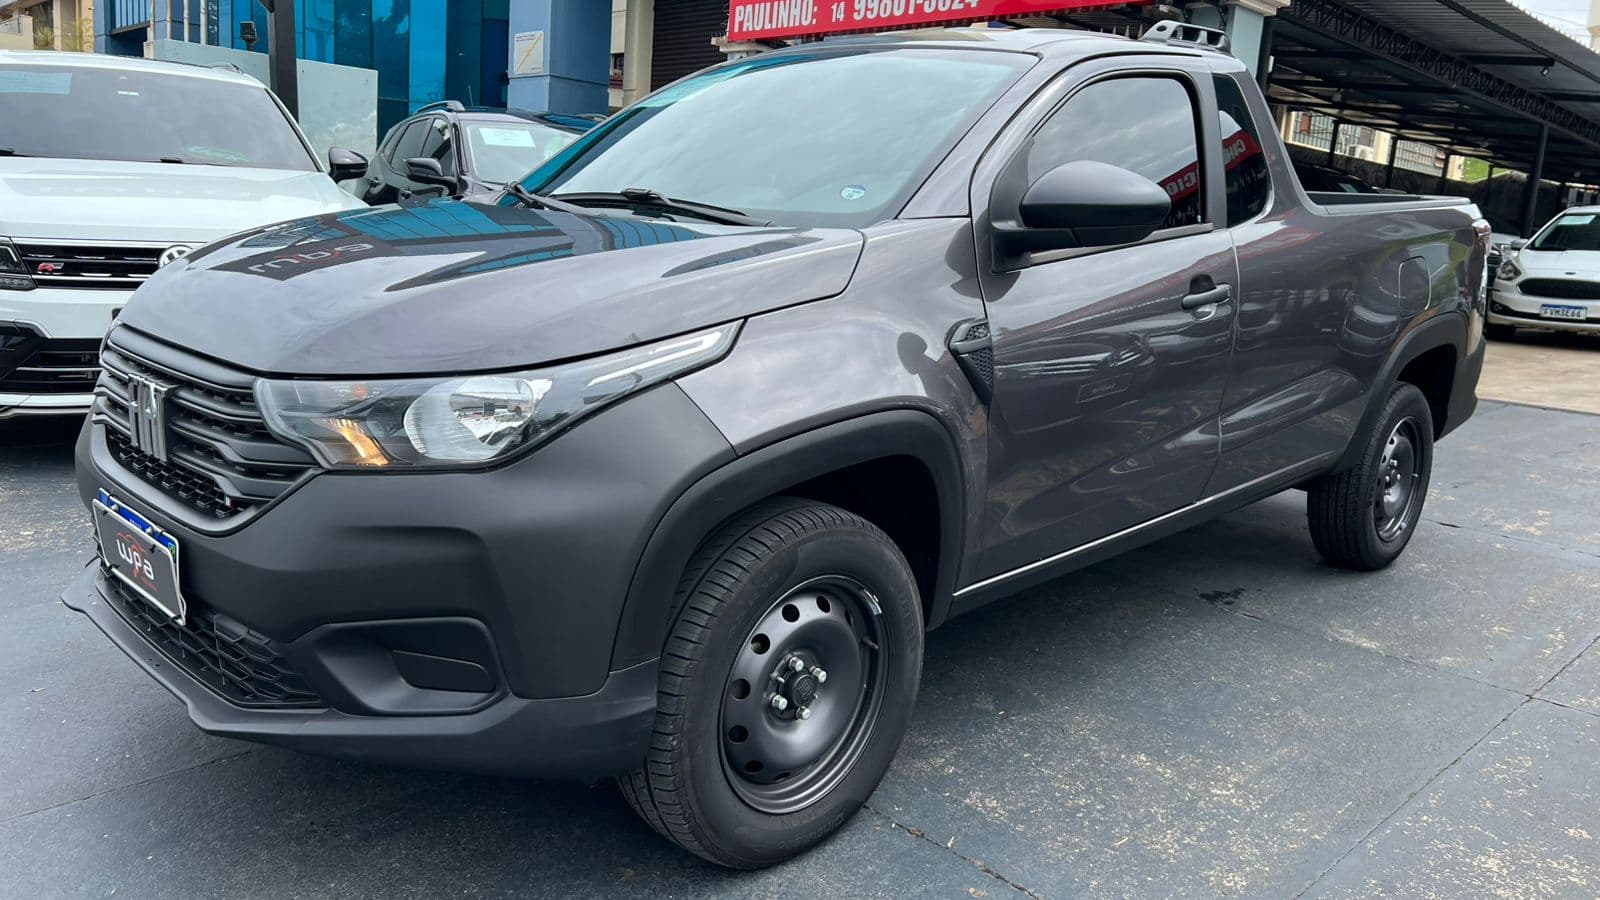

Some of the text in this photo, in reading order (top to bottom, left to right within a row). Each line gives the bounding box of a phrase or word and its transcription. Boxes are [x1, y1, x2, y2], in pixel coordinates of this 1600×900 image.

[734, 0, 979, 32] PAULINHO: 14 99801-
[116, 538, 154, 581] wpa
